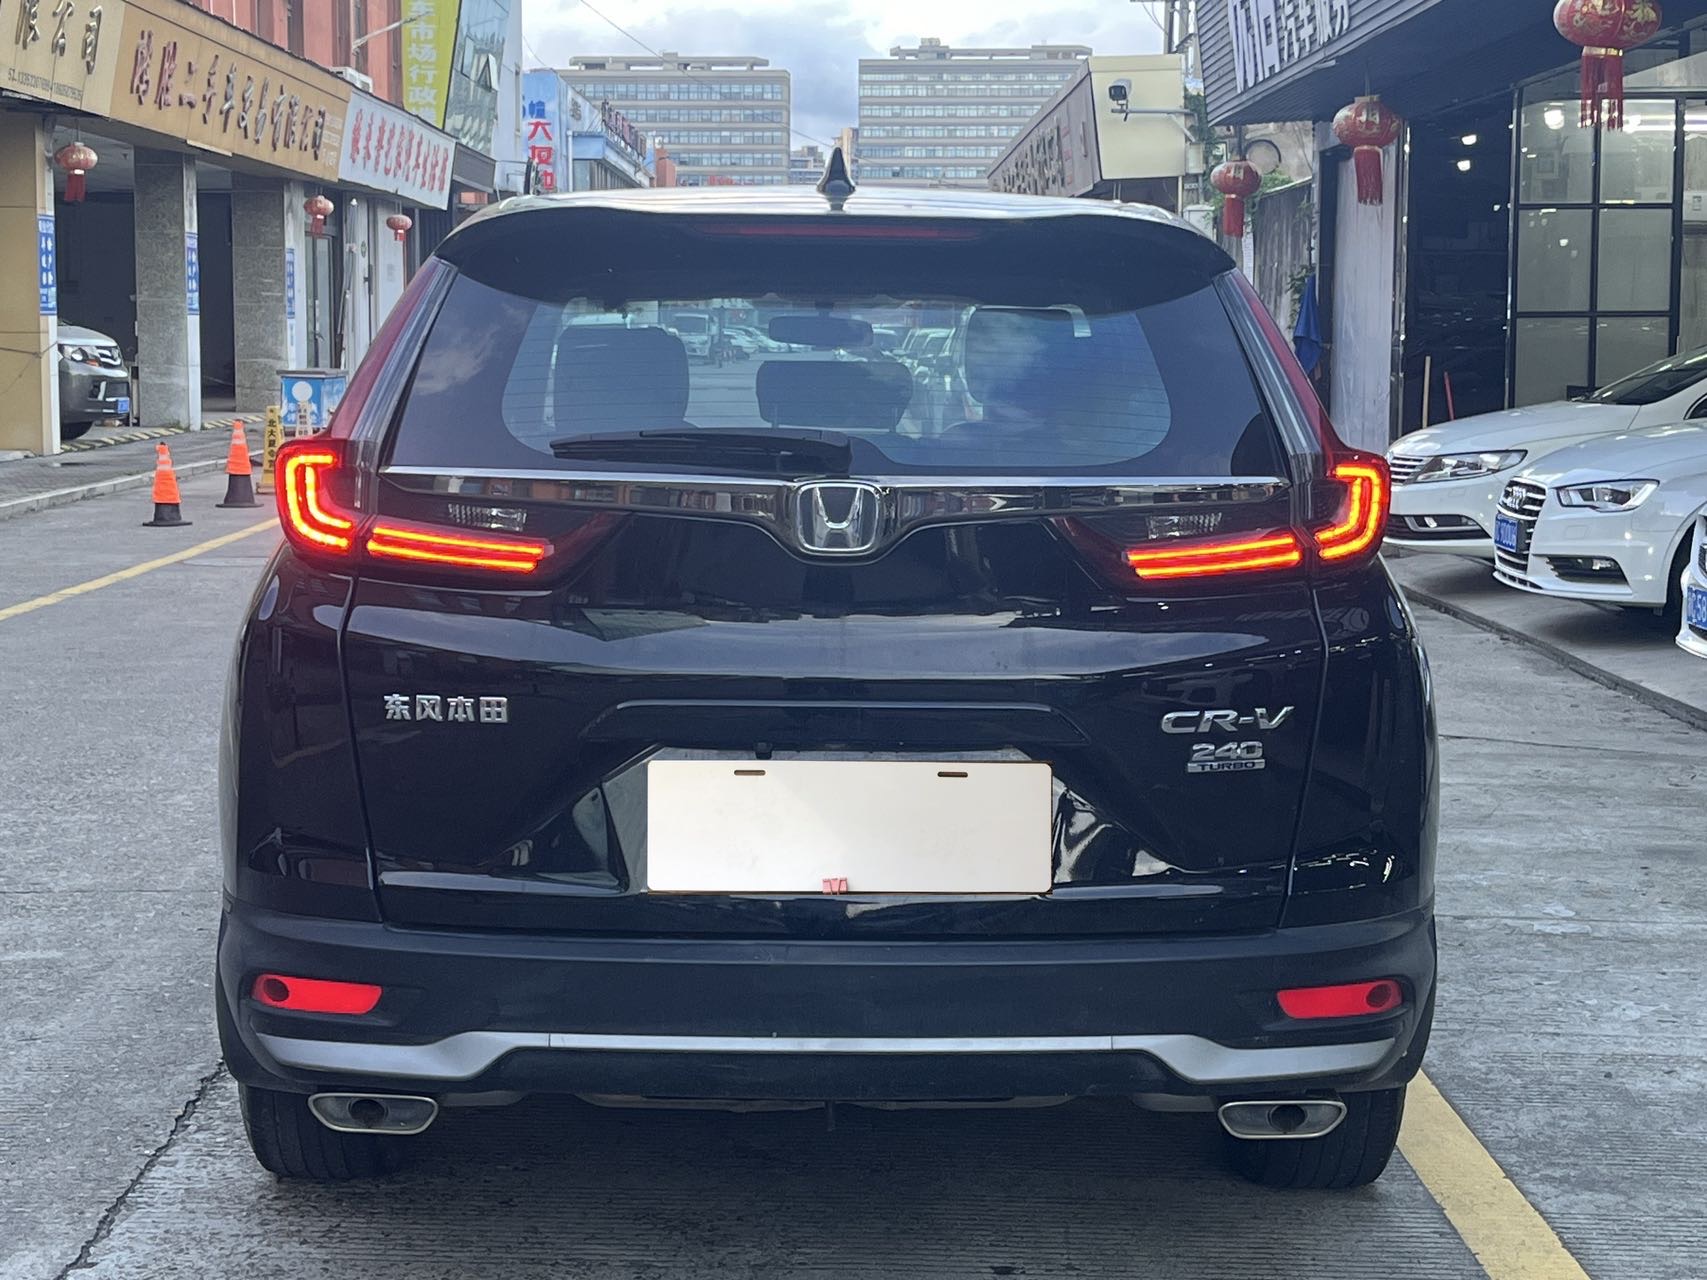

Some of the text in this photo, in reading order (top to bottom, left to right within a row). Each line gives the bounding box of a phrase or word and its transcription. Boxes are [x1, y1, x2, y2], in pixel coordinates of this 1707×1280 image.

[384, 694, 508, 723] 东风本田
[1161, 706, 1295, 733] CR-V
[1191, 741, 1263, 761] 240
[1198, 761, 1257, 771] TURBO
